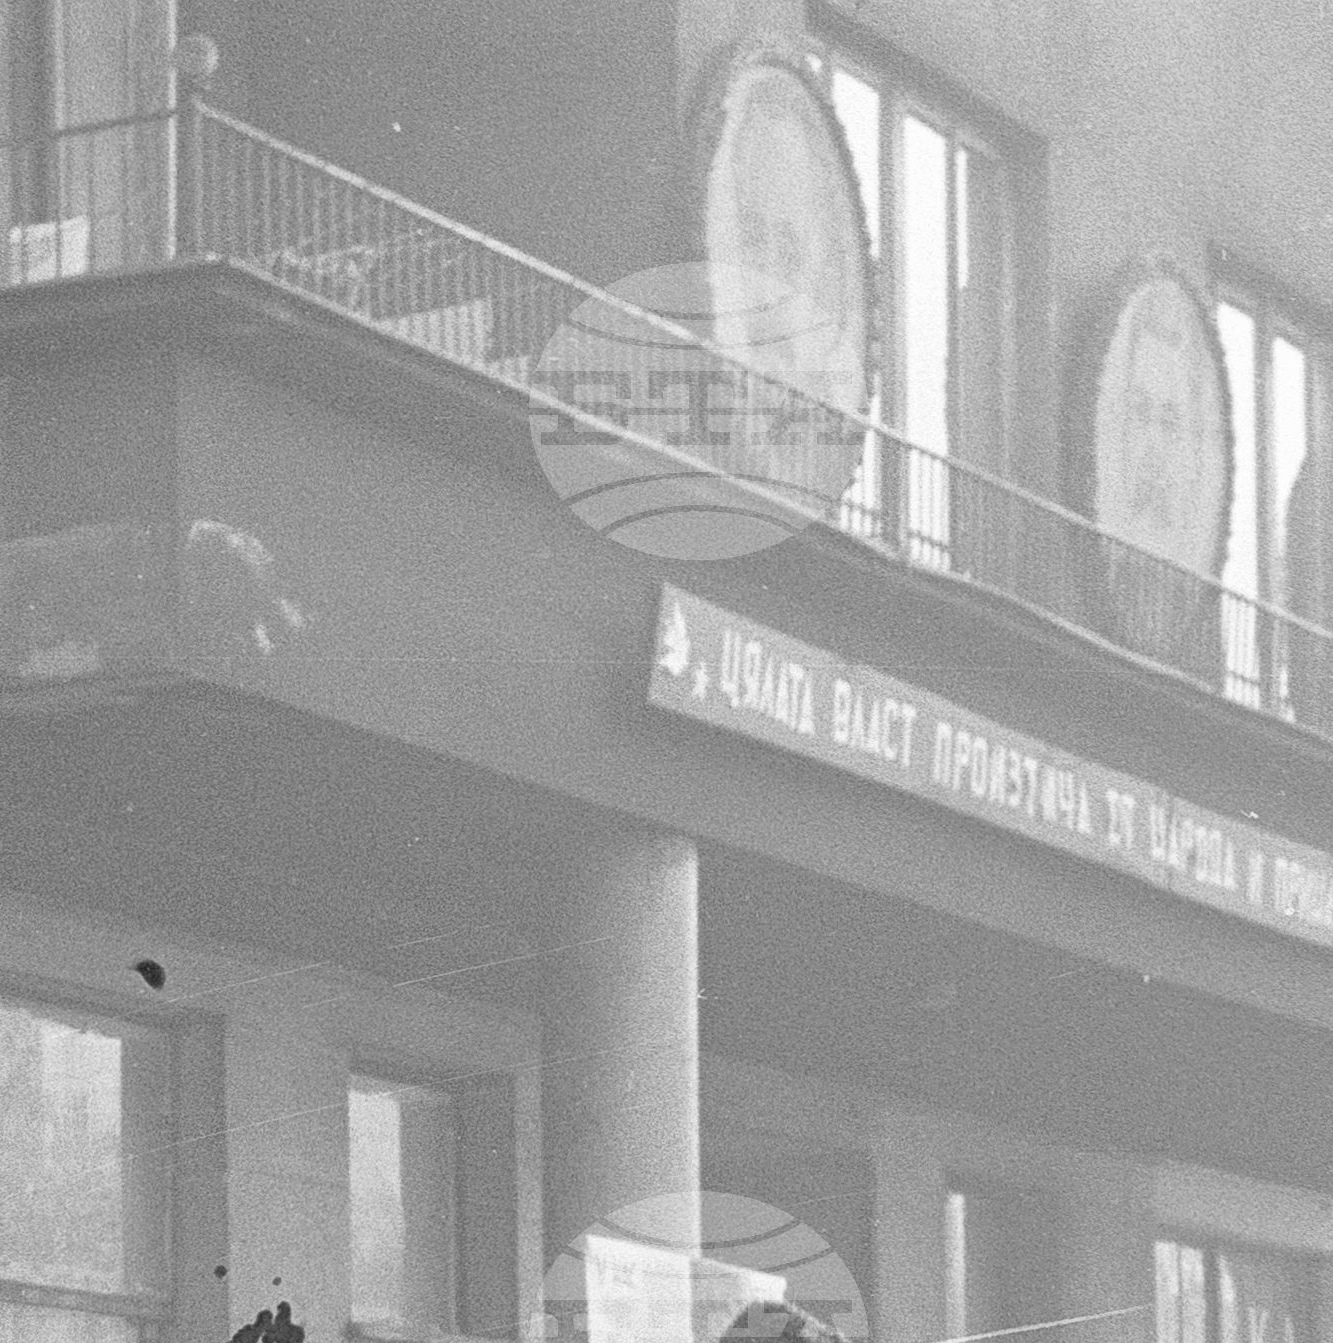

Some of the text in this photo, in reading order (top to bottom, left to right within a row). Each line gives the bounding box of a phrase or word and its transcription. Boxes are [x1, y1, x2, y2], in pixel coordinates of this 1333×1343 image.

[719, 628, 816, 737] ЦЯЛАТА
[832, 678, 917, 768] ВЛАСТ
[931, 721, 1095, 835] ПРОИЗТИЧА
